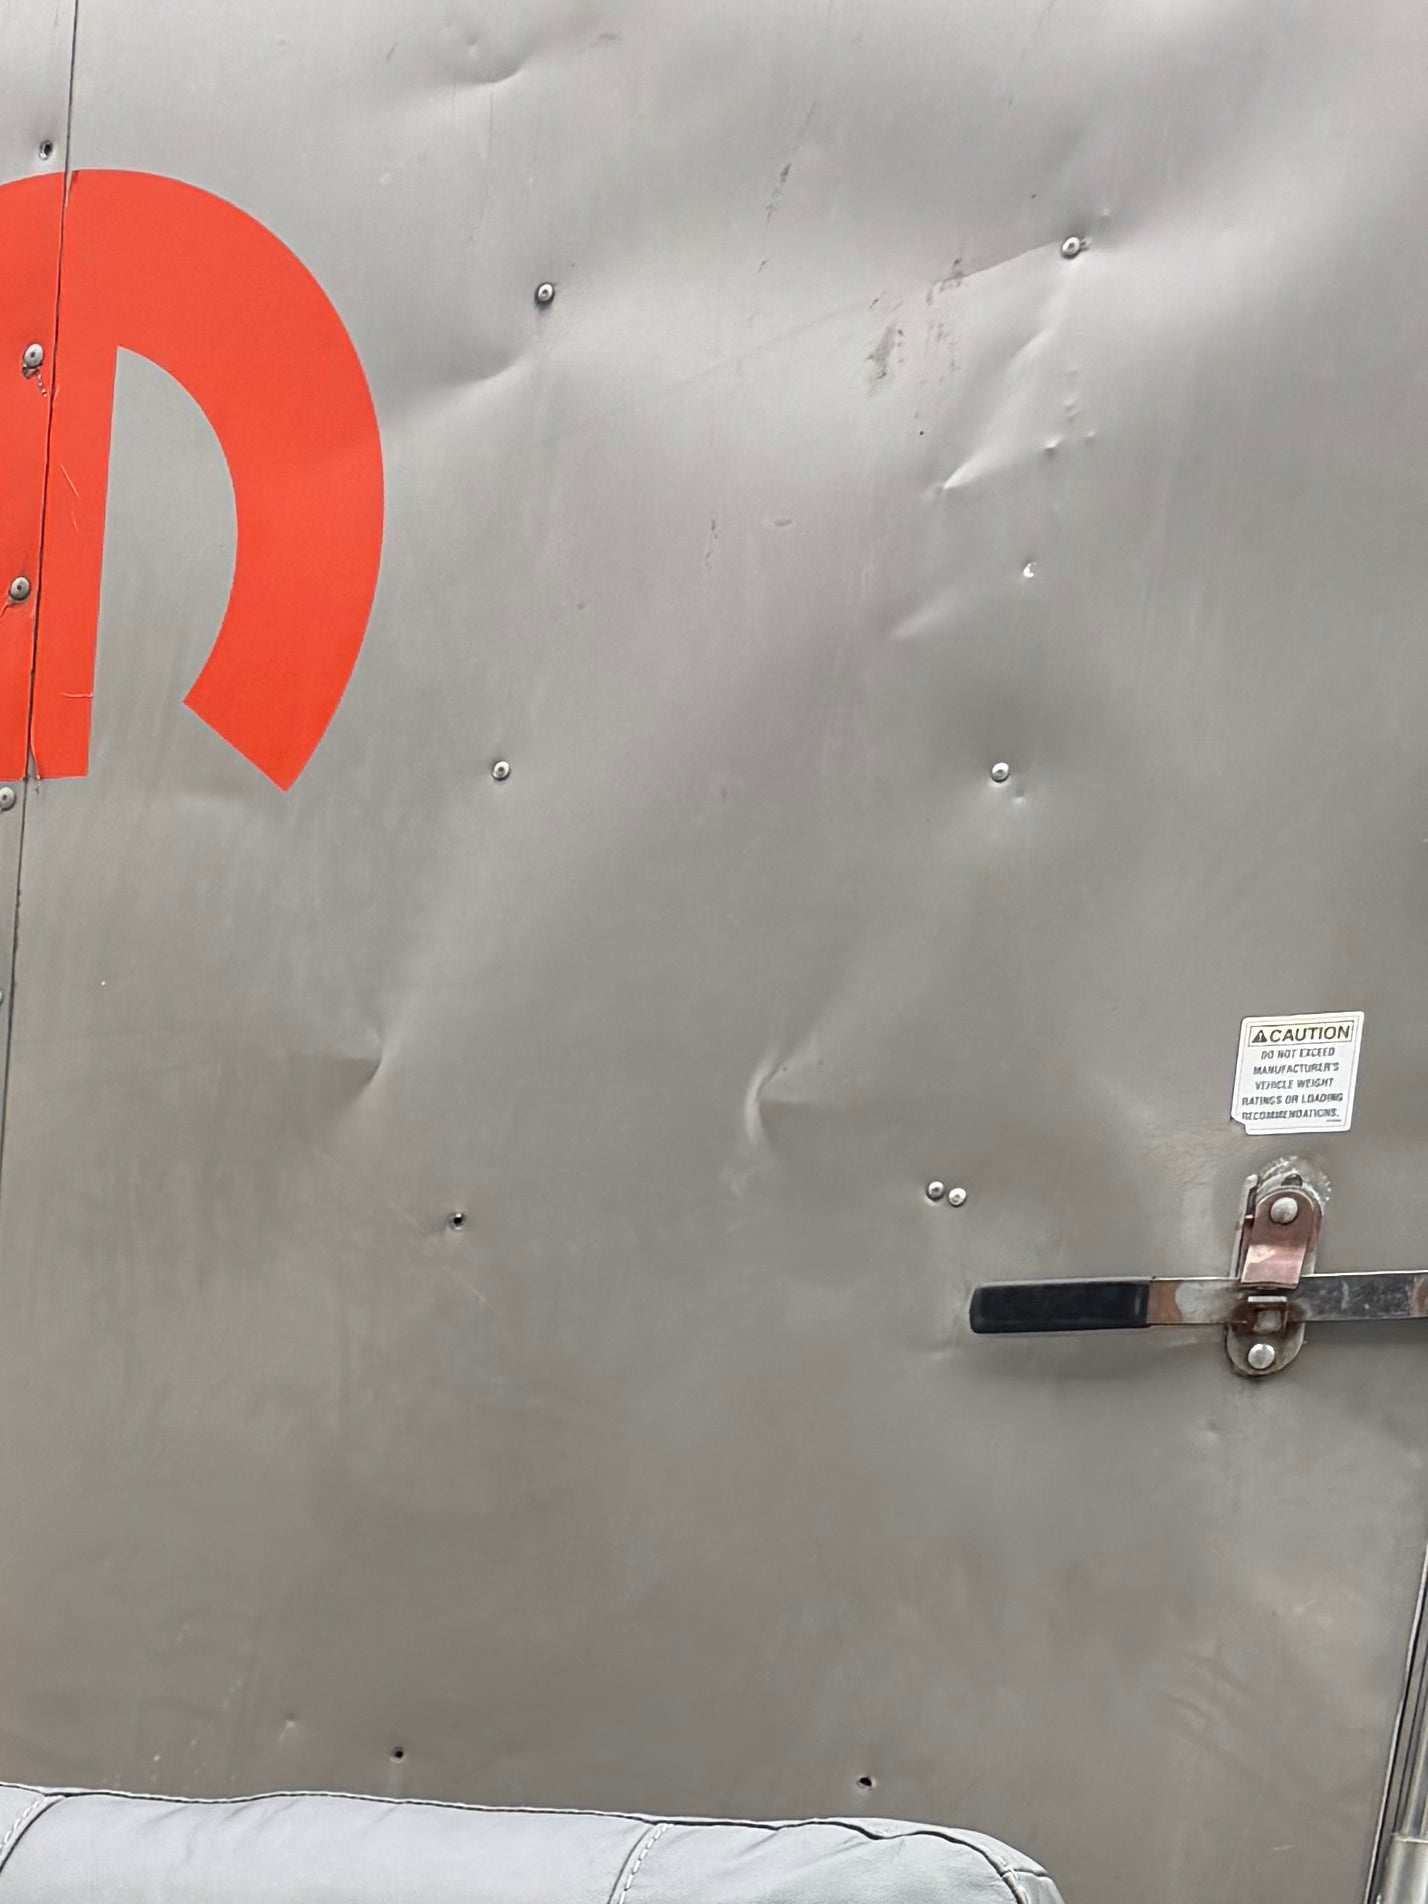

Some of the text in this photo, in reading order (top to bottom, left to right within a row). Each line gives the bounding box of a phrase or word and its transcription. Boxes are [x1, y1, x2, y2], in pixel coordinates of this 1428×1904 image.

[1269, 1025, 1350, 1043] CAUTION
[1261, 1047, 1336, 1060] DO NOT EXCEED
[1253, 1062, 1340, 1075] MANUFACTURER'S
[1255, 1078, 1334, 1090] VEHICLE WEIGHT
[1241, 1093, 1344, 1106] RATINGS OR LOADING
